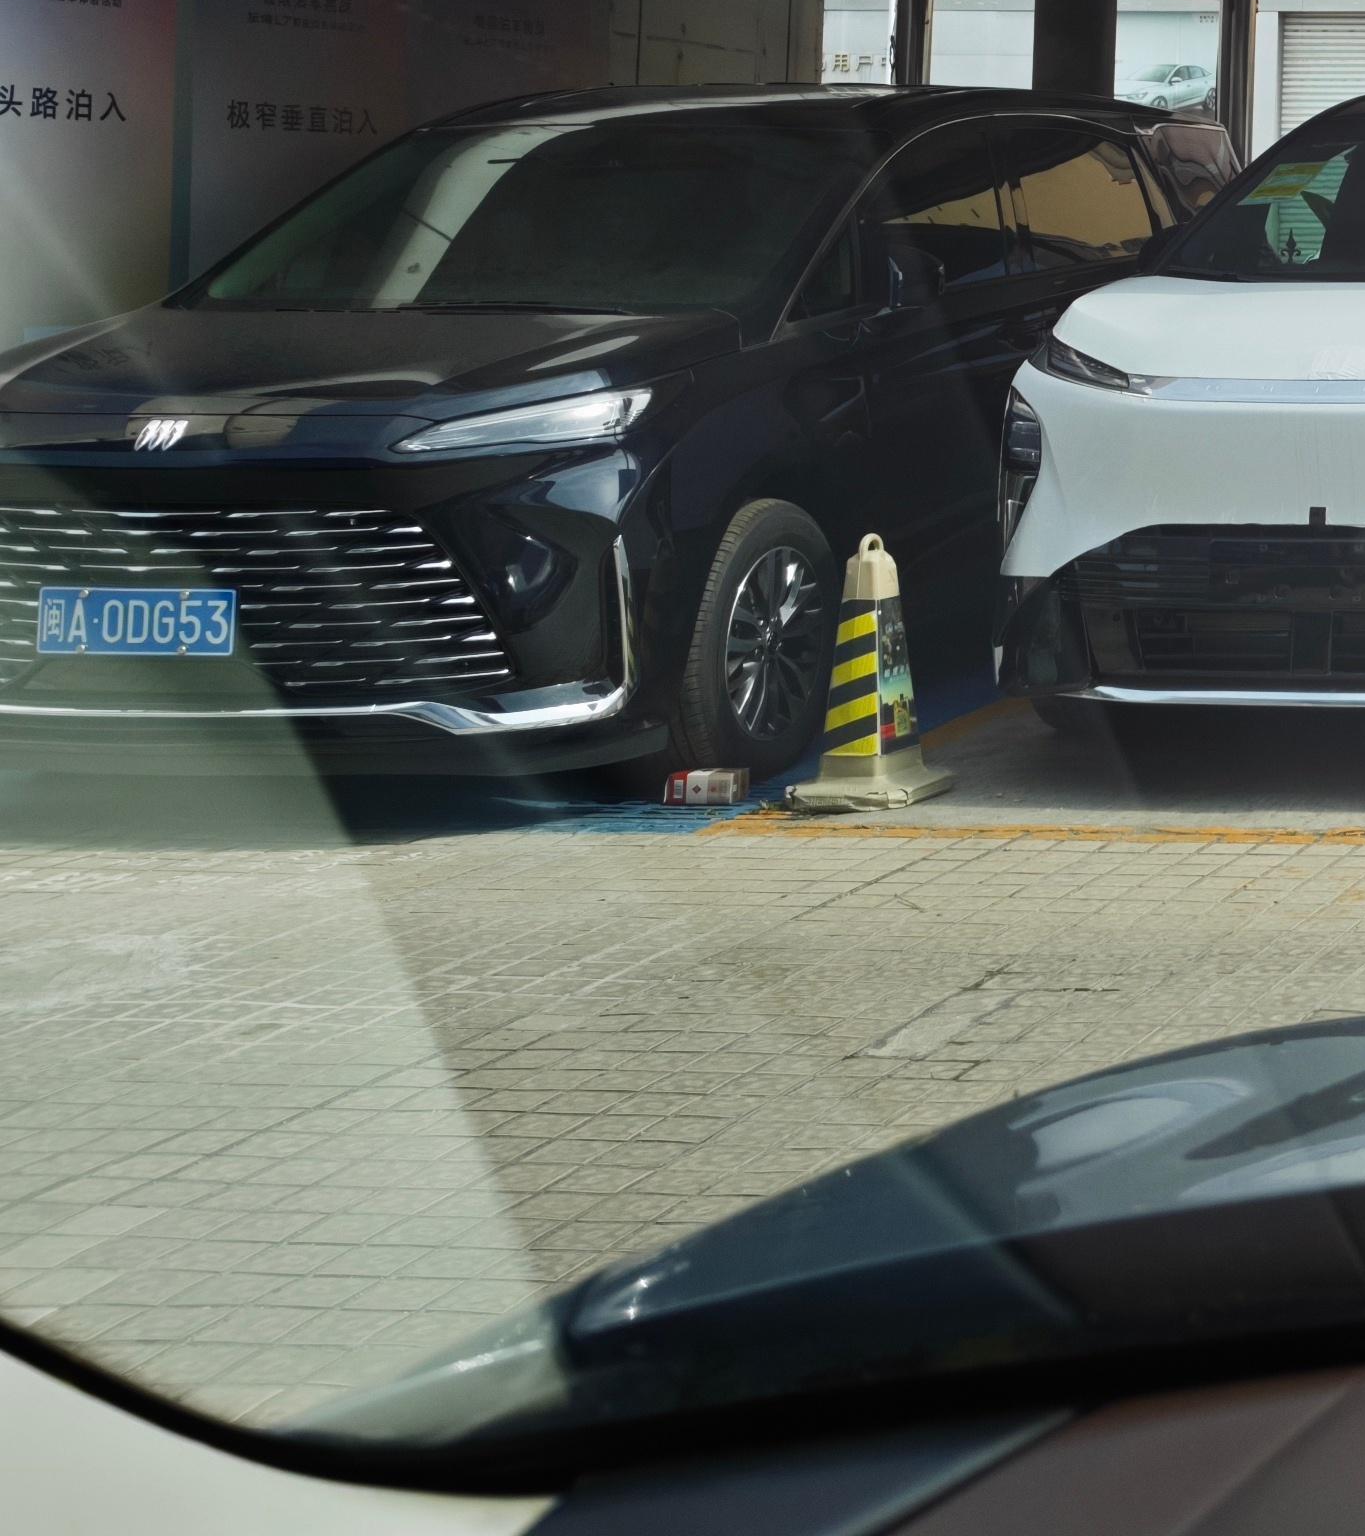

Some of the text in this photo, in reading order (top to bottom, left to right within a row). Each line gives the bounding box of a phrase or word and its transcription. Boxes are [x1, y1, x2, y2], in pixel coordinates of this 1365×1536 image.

[226, 99, 378, 135] 极窄垂直泊入
